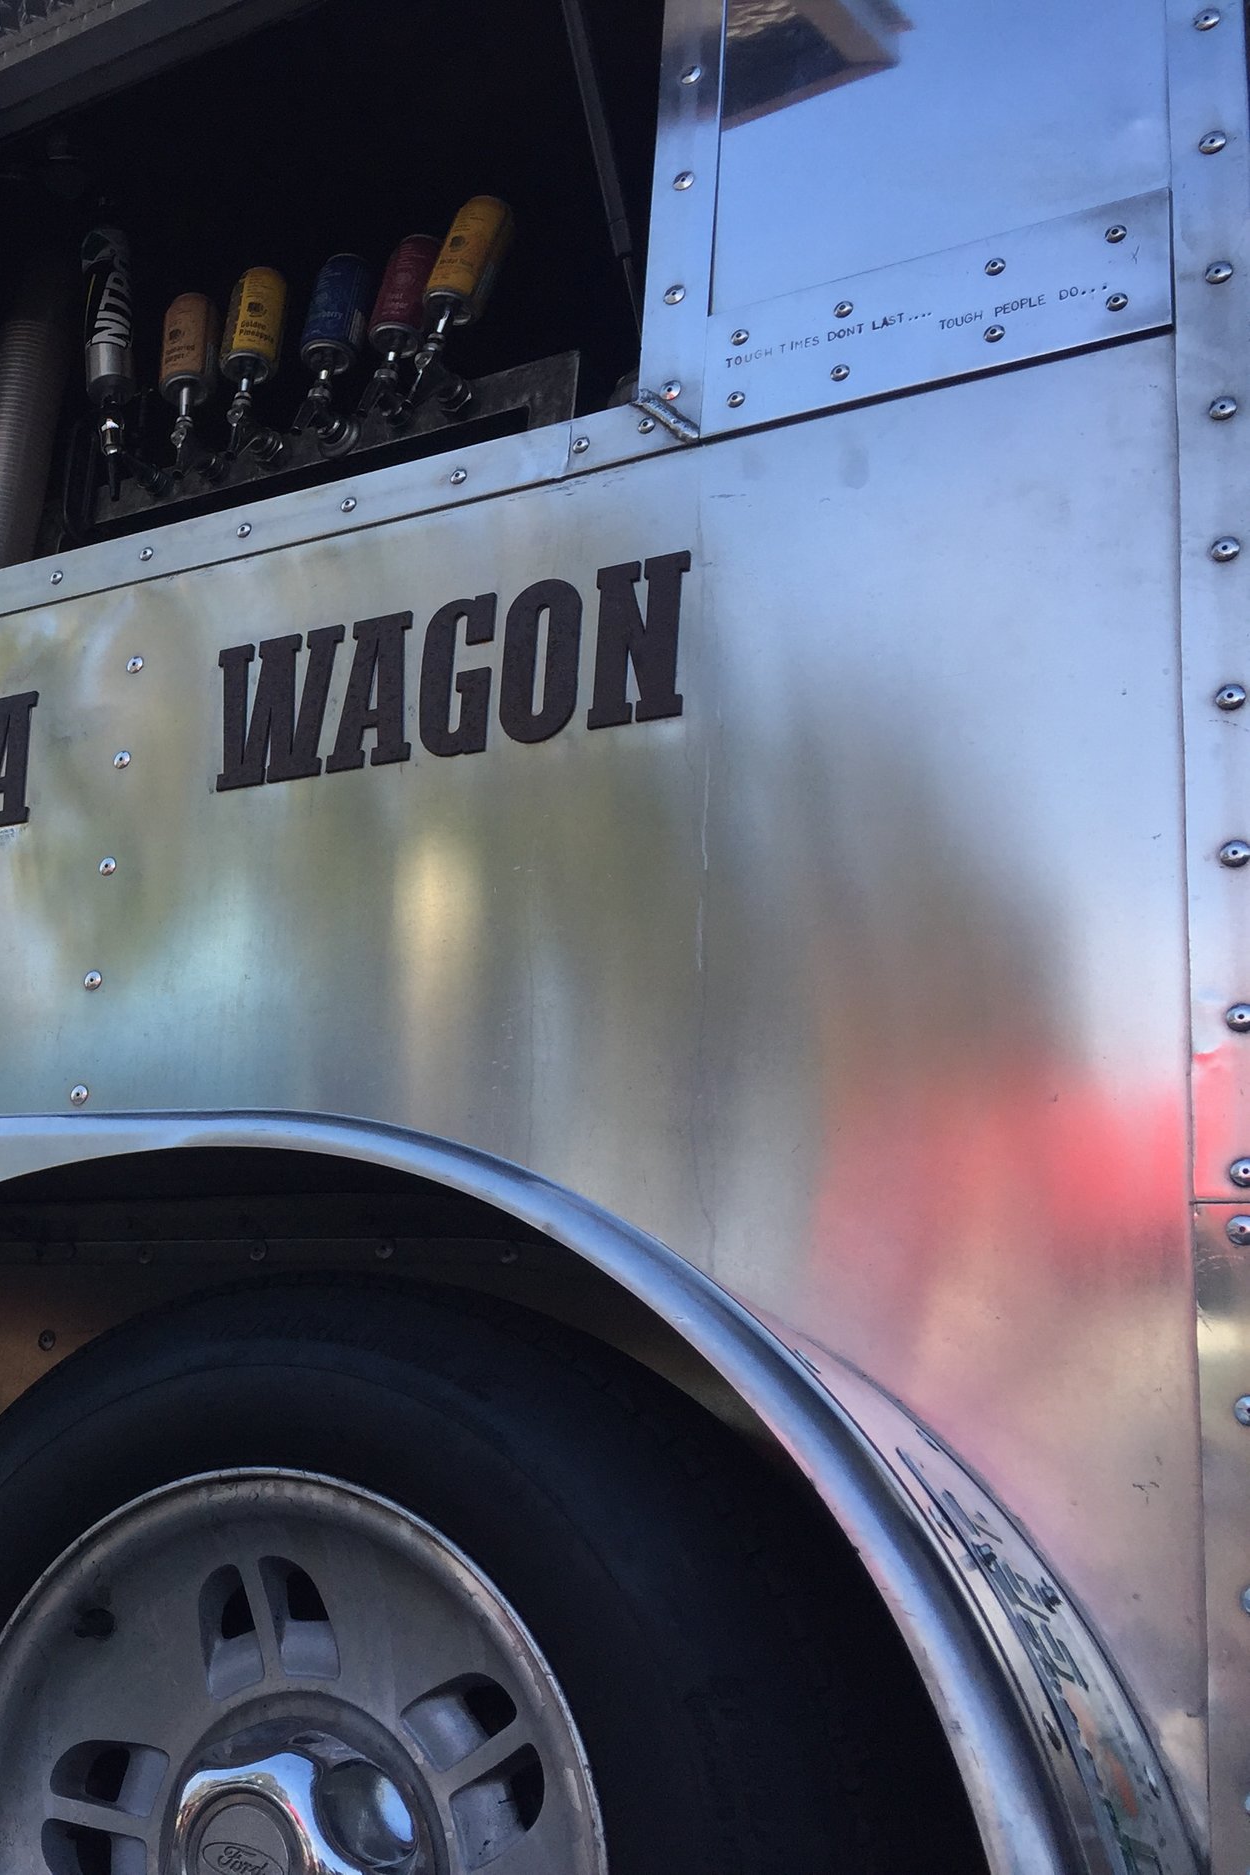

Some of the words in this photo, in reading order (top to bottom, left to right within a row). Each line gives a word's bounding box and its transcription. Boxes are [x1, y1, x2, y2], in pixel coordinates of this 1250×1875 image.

[725, 347, 773, 369] TOUGH
[779, 335, 820, 354] TIMES
[827, 323, 864, 342] DONT
[938, 310, 984, 330] TOUGH
[994, 294, 1047, 317] PEOPLE
[215, 549, 692, 792] WAGON
